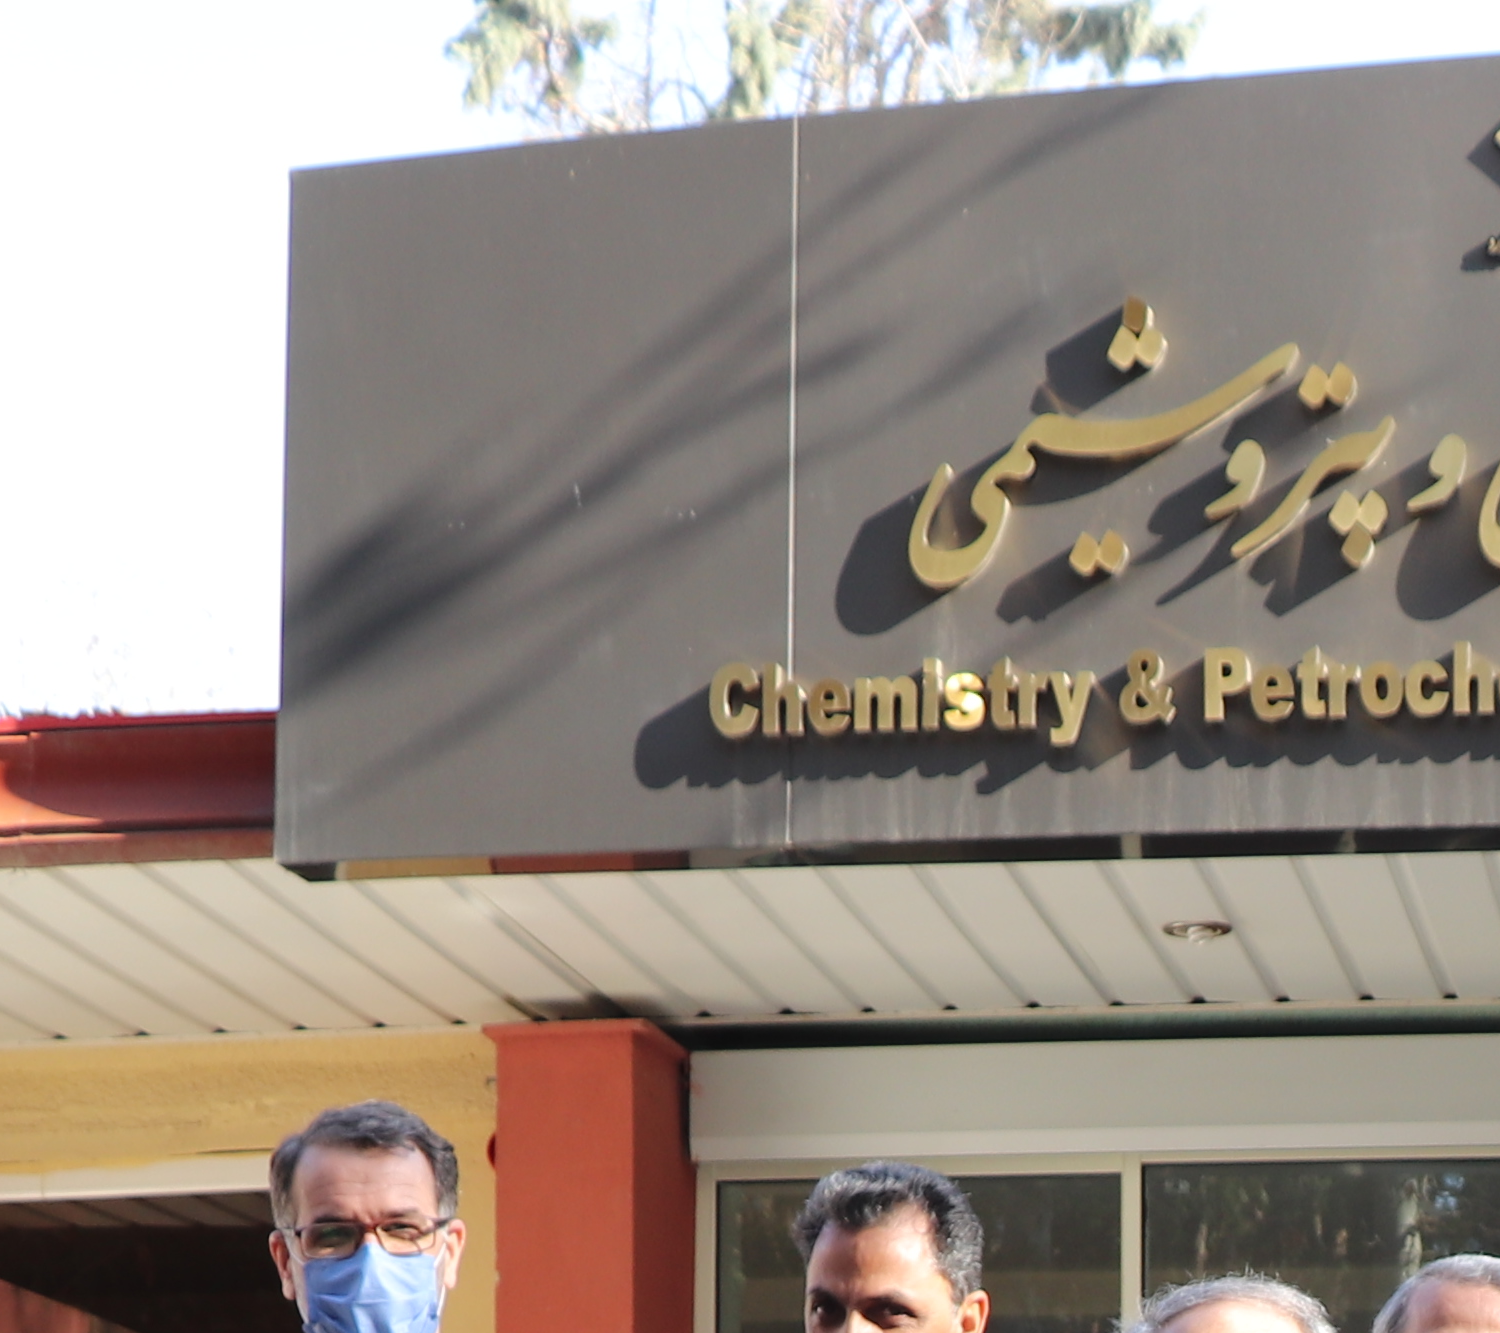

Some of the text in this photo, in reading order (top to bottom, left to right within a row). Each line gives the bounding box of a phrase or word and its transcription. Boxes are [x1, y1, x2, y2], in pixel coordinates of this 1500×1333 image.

[1407, 434, 1466, 515] و
[708, 657, 1094, 747] Chemistry
[1120, 649, 1177, 728] &
